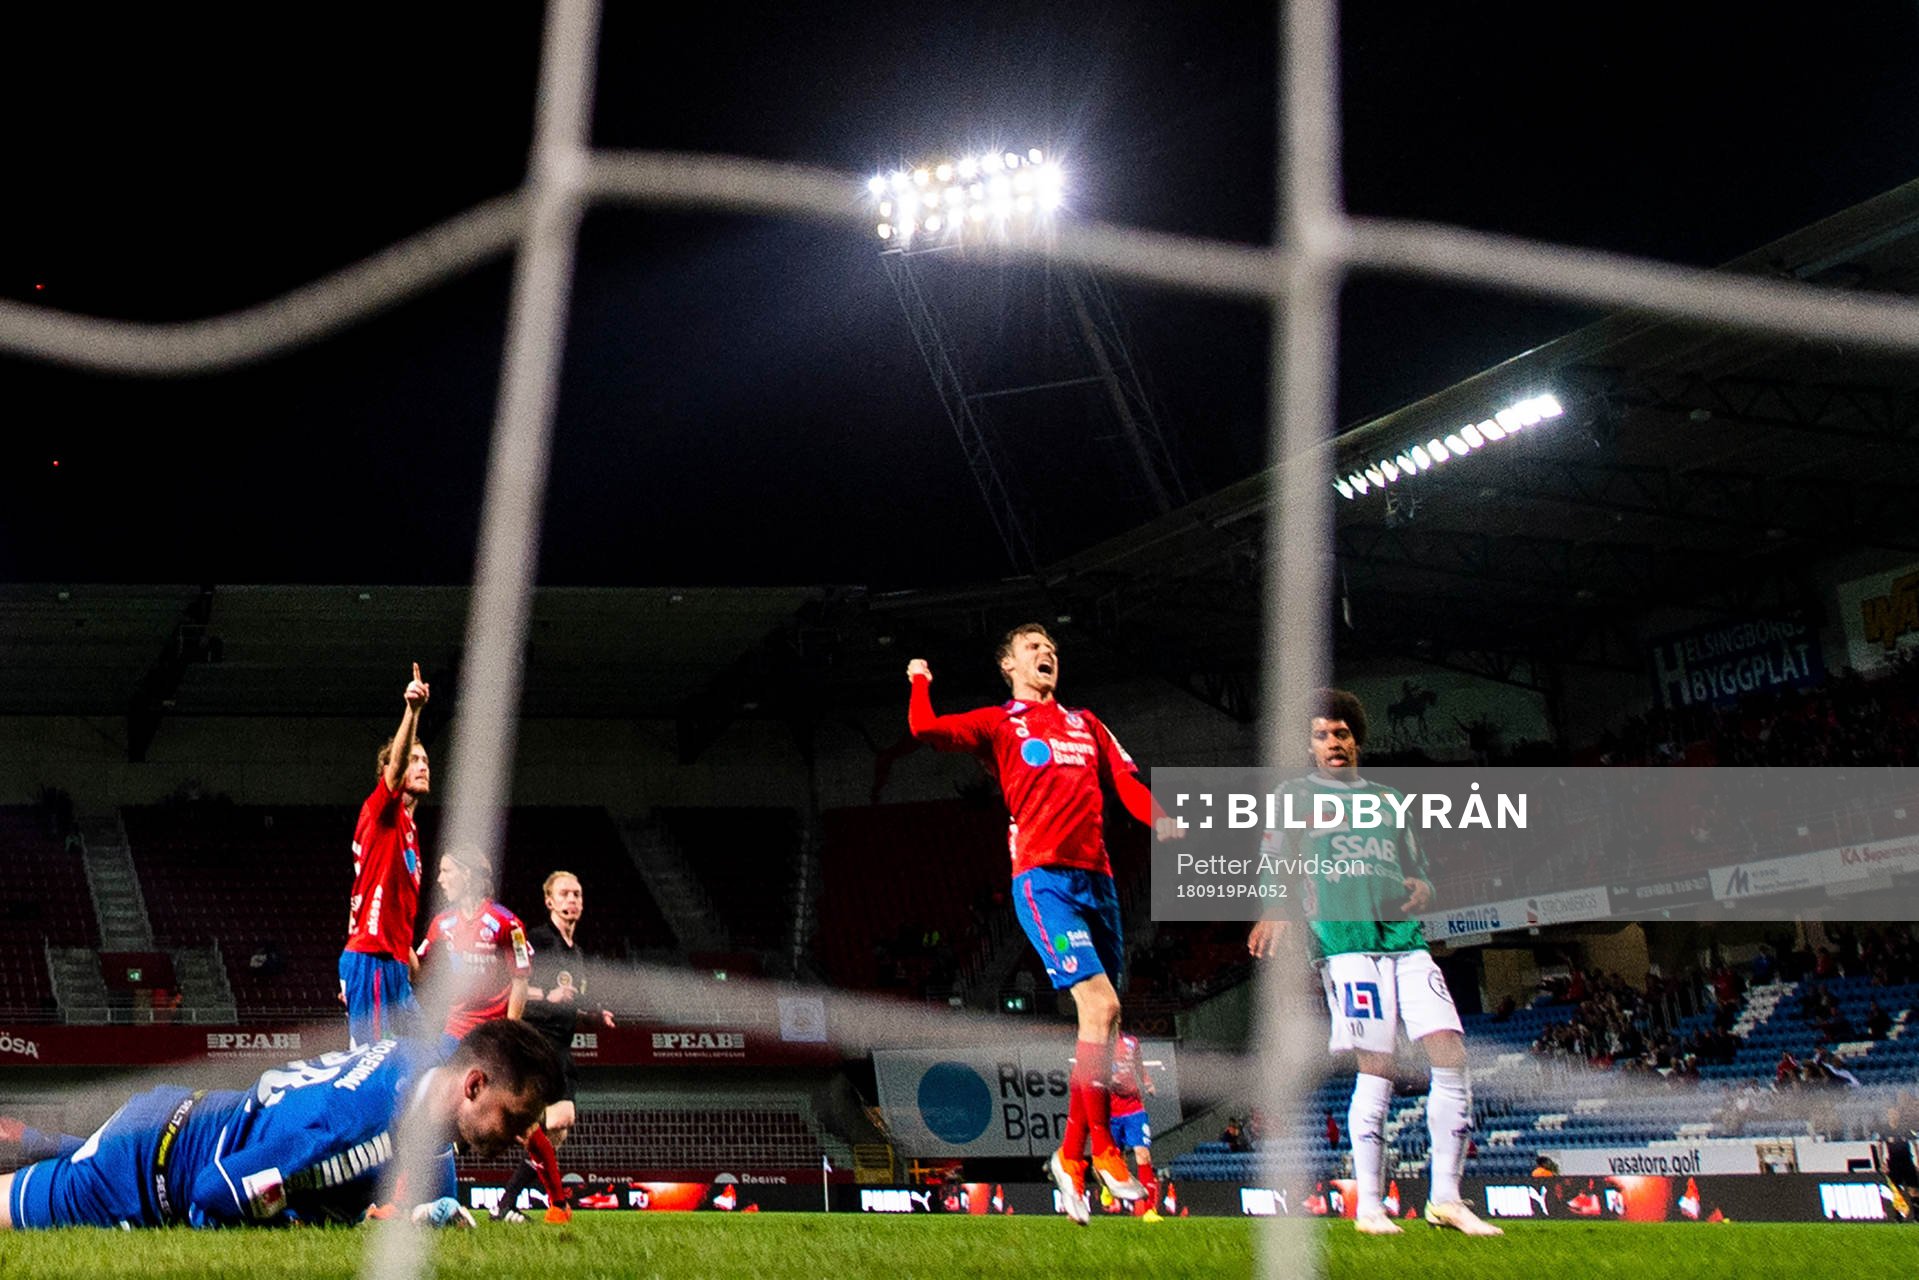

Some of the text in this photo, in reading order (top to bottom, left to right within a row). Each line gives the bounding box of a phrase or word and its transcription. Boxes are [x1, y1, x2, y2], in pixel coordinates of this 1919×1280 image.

[1331, 835, 1396, 864] SSAB
[219, 1033, 290, 1050] PEAB
[664, 1032, 734, 1049] PEAB
[998, 1062, 1068, 1099] Res
[1609, 1149, 1700, 1176] vasatorp.golf
[861, 1190, 912, 1213] PUMA
[1818, 1183, 1887, 1220] PUMA
